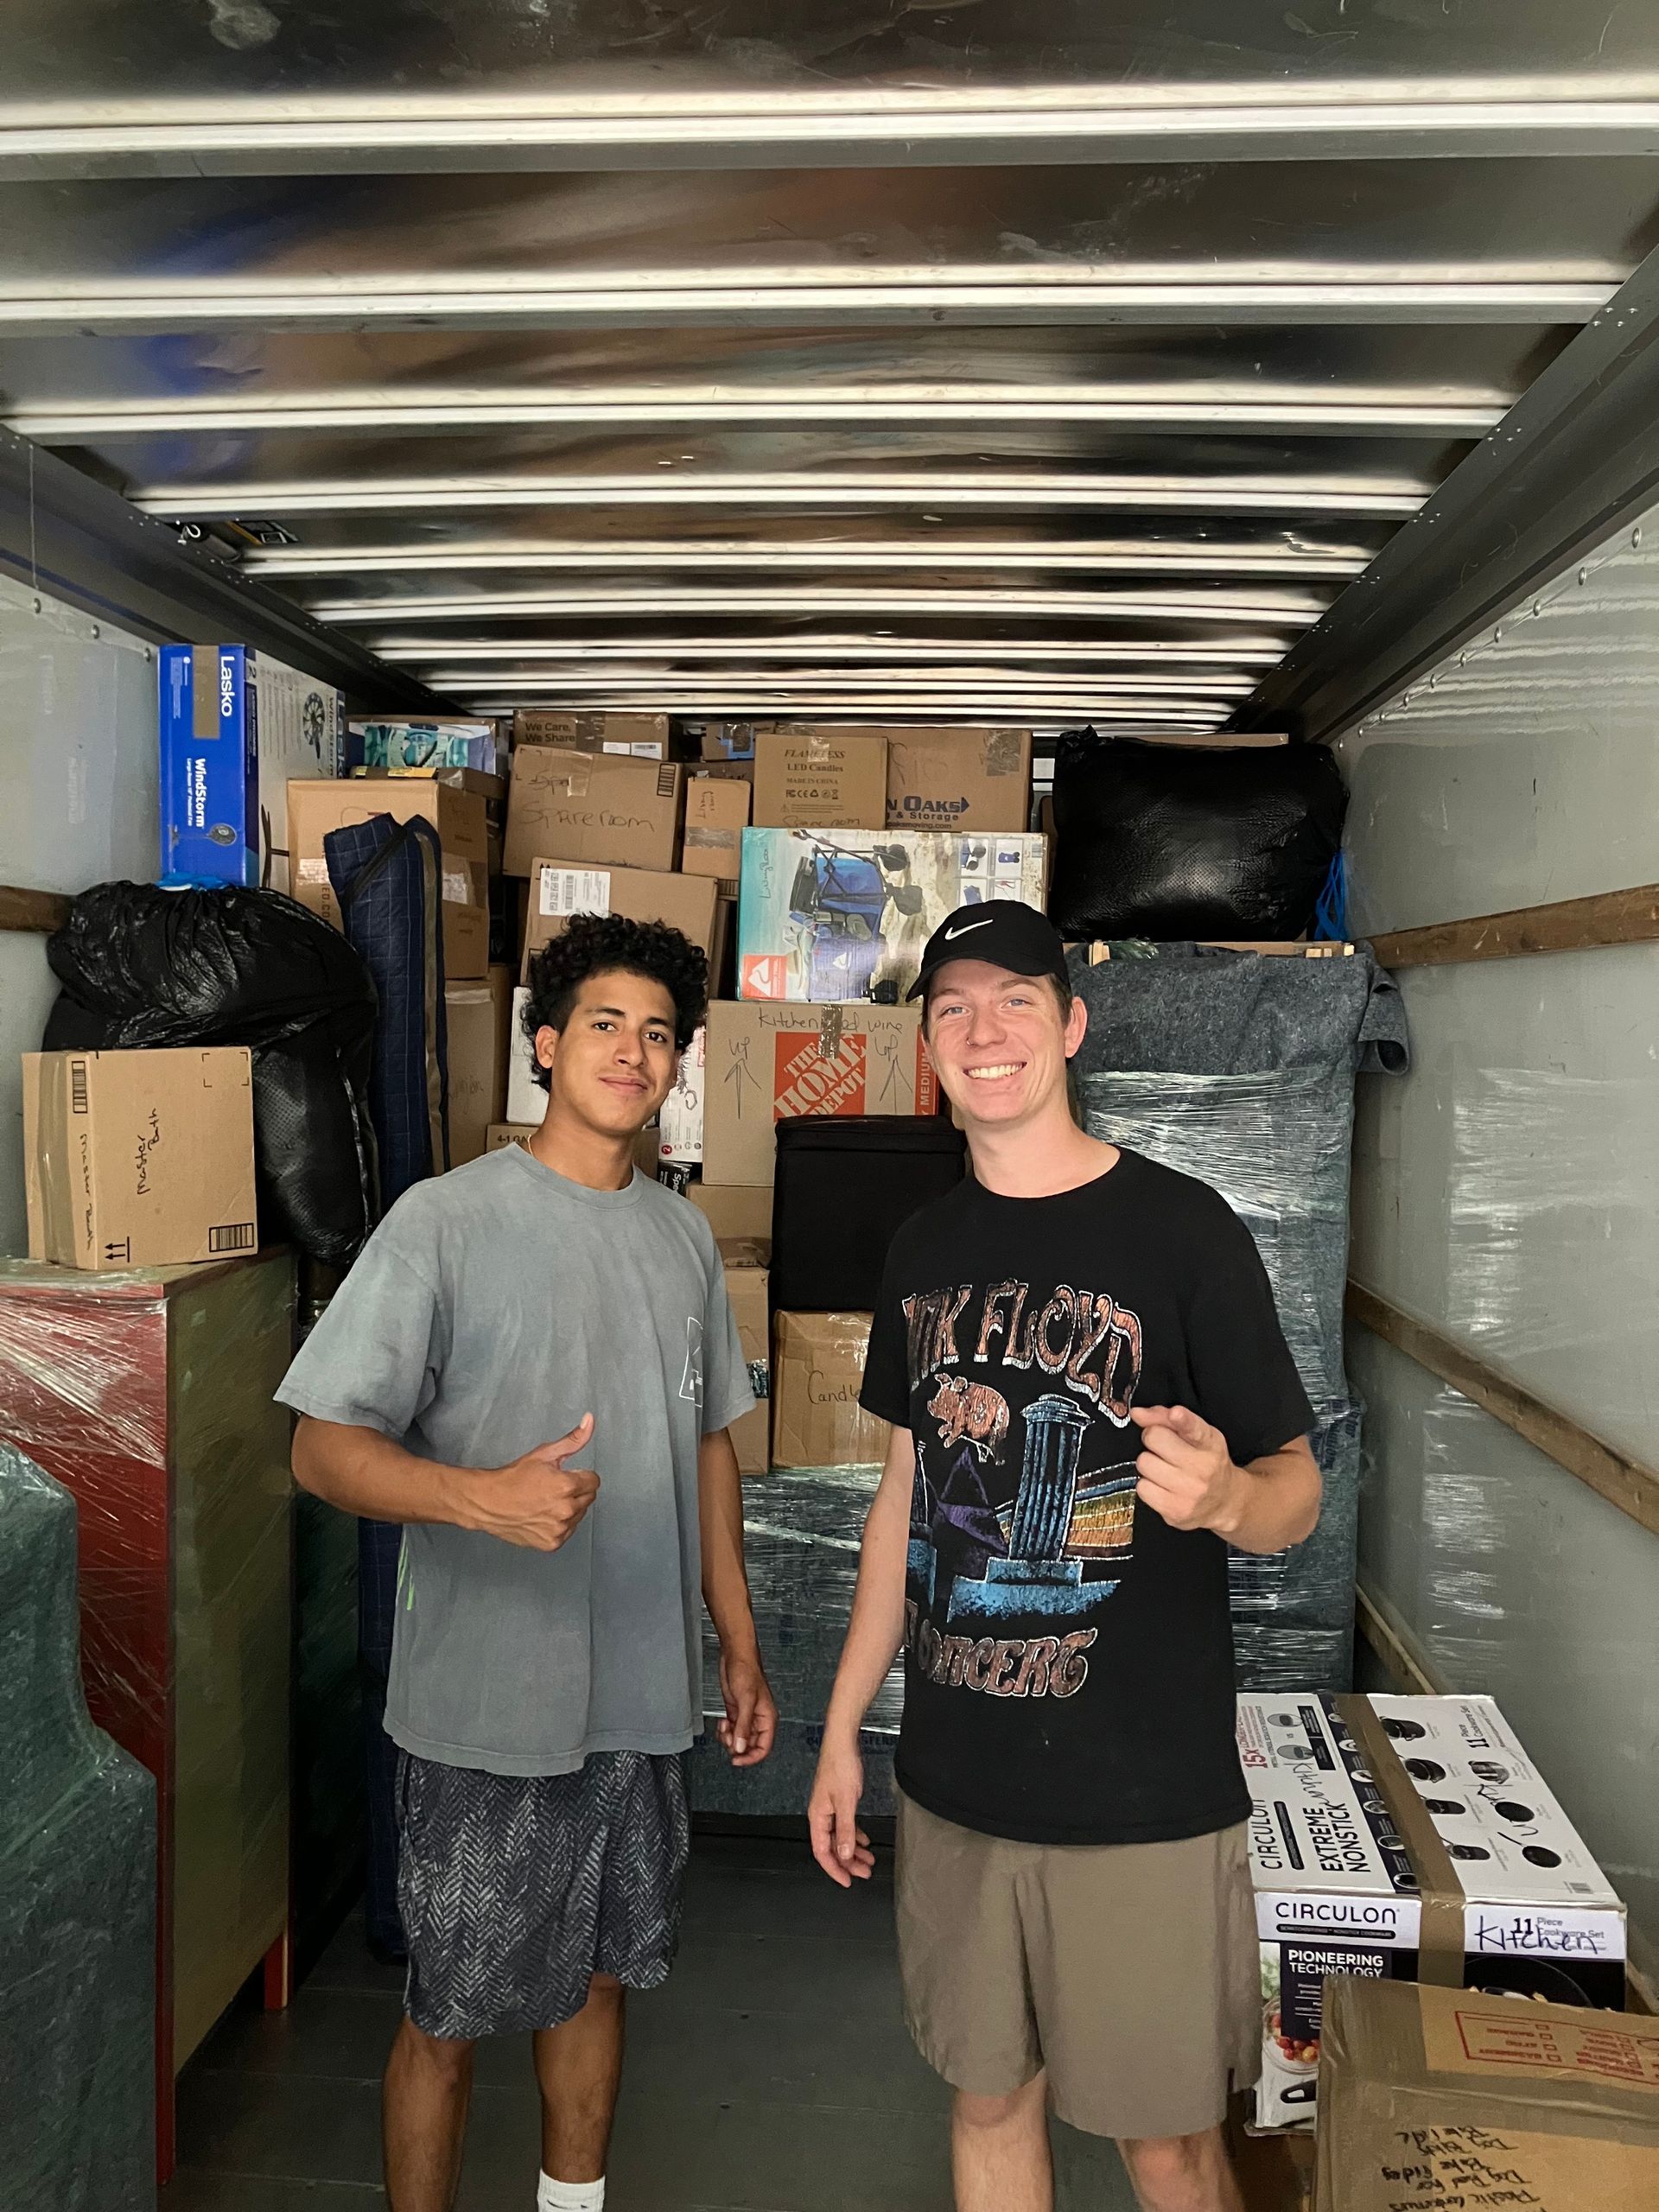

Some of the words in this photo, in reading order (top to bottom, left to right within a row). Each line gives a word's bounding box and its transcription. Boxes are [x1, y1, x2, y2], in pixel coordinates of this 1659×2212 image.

[220, 656, 235, 717] Lasko
[524, 722, 542, 731] We
[545, 722, 571, 732] Care,
[525, 734, 543, 742] We
[545, 734, 575, 742] Share
[787, 763, 807, 772] LED
[809, 764, 844, 772] Candles
[195, 758, 207, 827] WindStorm
[887, 821, 952, 830] oaksmoving.com
[910, 812, 959, 823] Storage
[758, 1007, 819, 1029] Kitchen
[868, 1019, 903, 1034] wine
[784, 1041, 819, 1078] THE
[773, 1033, 867, 1117] HOME
[810, 1067, 866, 1116] DEPOT
[147, 1107, 160, 1151] Bath
[135, 1134, 151, 1195] Master
[973, 1278, 1143, 1428] FLOYD
[1465, 1738, 1491, 1749] 11
[1302, 1806, 1345, 1872] EXTREME
[1325, 1802, 1371, 1873] NONSTICK
[1275, 1902, 1397, 1925] CIRCULON
[1536, 1916, 1563, 1927] Piece
[1475, 1916, 1599, 1955] Kitchen
[1513, 1917, 1533, 1936] 11
[1588, 1929, 1605, 1939] Set
[1288, 1948, 1384, 1967] PIONEERING
[1288, 1961, 1383, 1978] TECHNOLOGY
